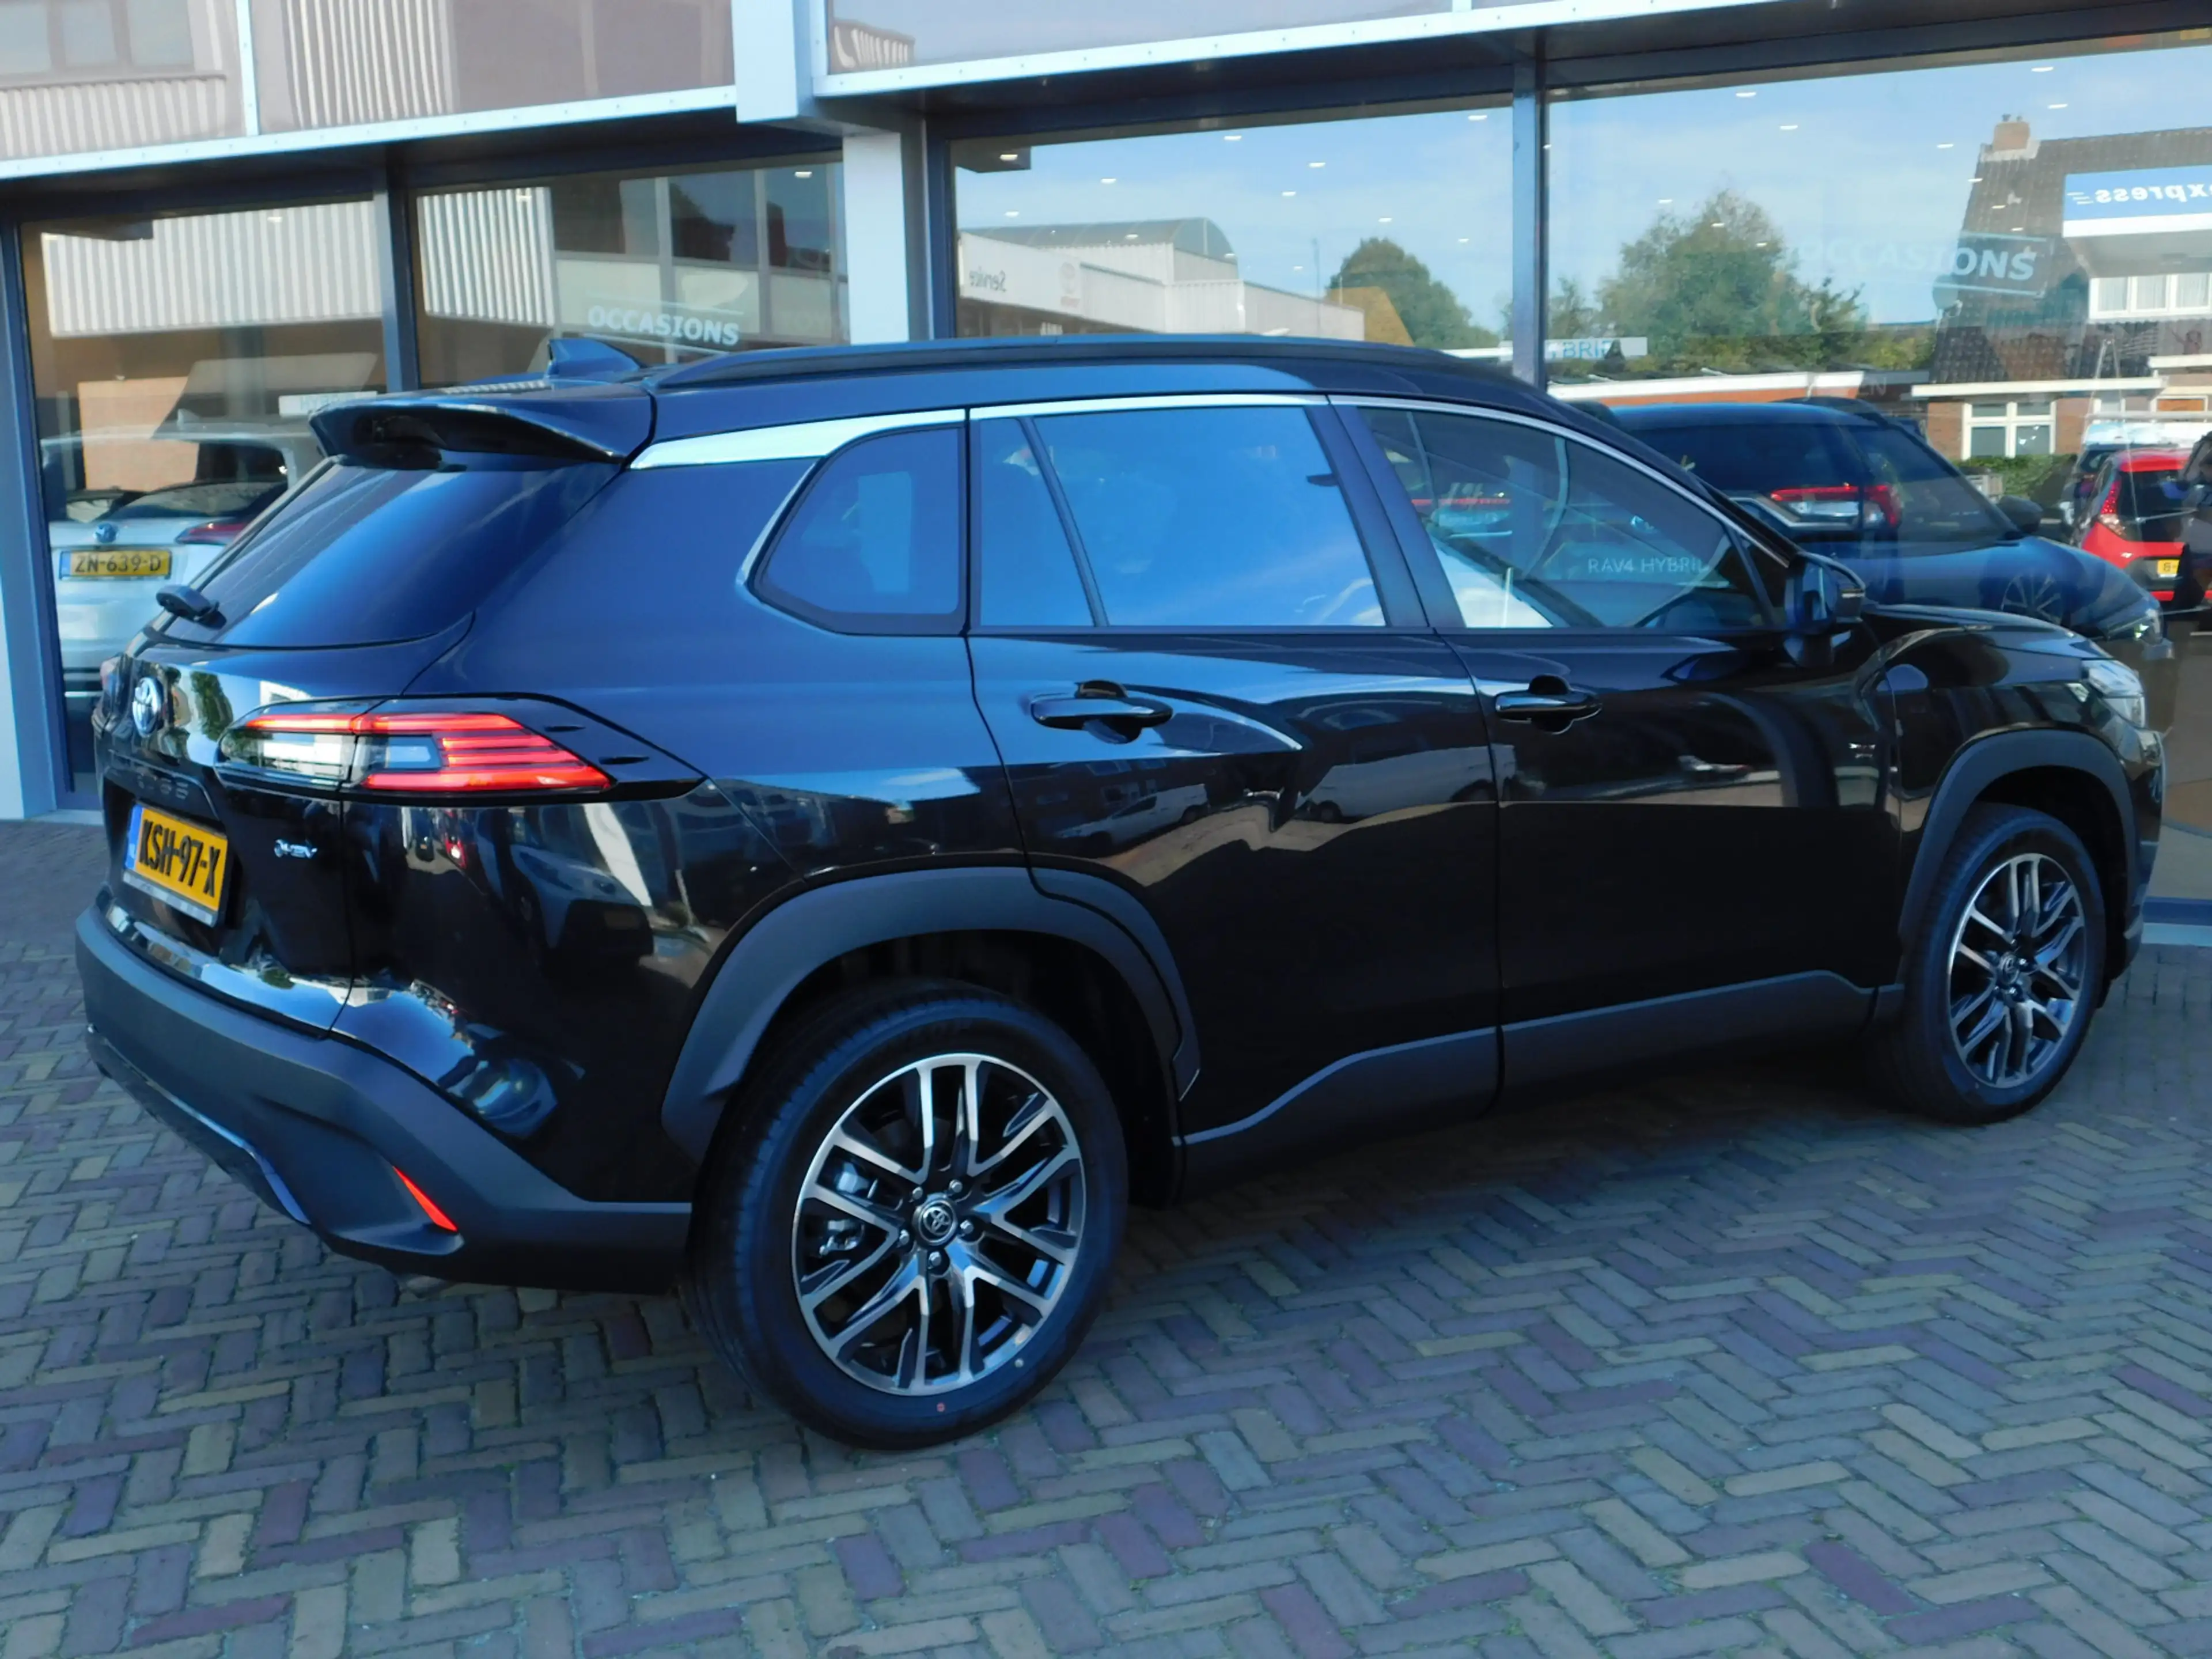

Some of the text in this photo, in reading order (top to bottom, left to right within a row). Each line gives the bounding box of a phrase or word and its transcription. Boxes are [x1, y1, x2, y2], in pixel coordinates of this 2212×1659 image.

[1800, 234, 2037, 282] OCCASIONS
[588, 305, 739, 345] OCCASIONS
[74, 554, 162, 573] ZN-639-D
[1588, 557, 1634, 573] RAV4
[139, 819, 221, 897] KSH-97-X
